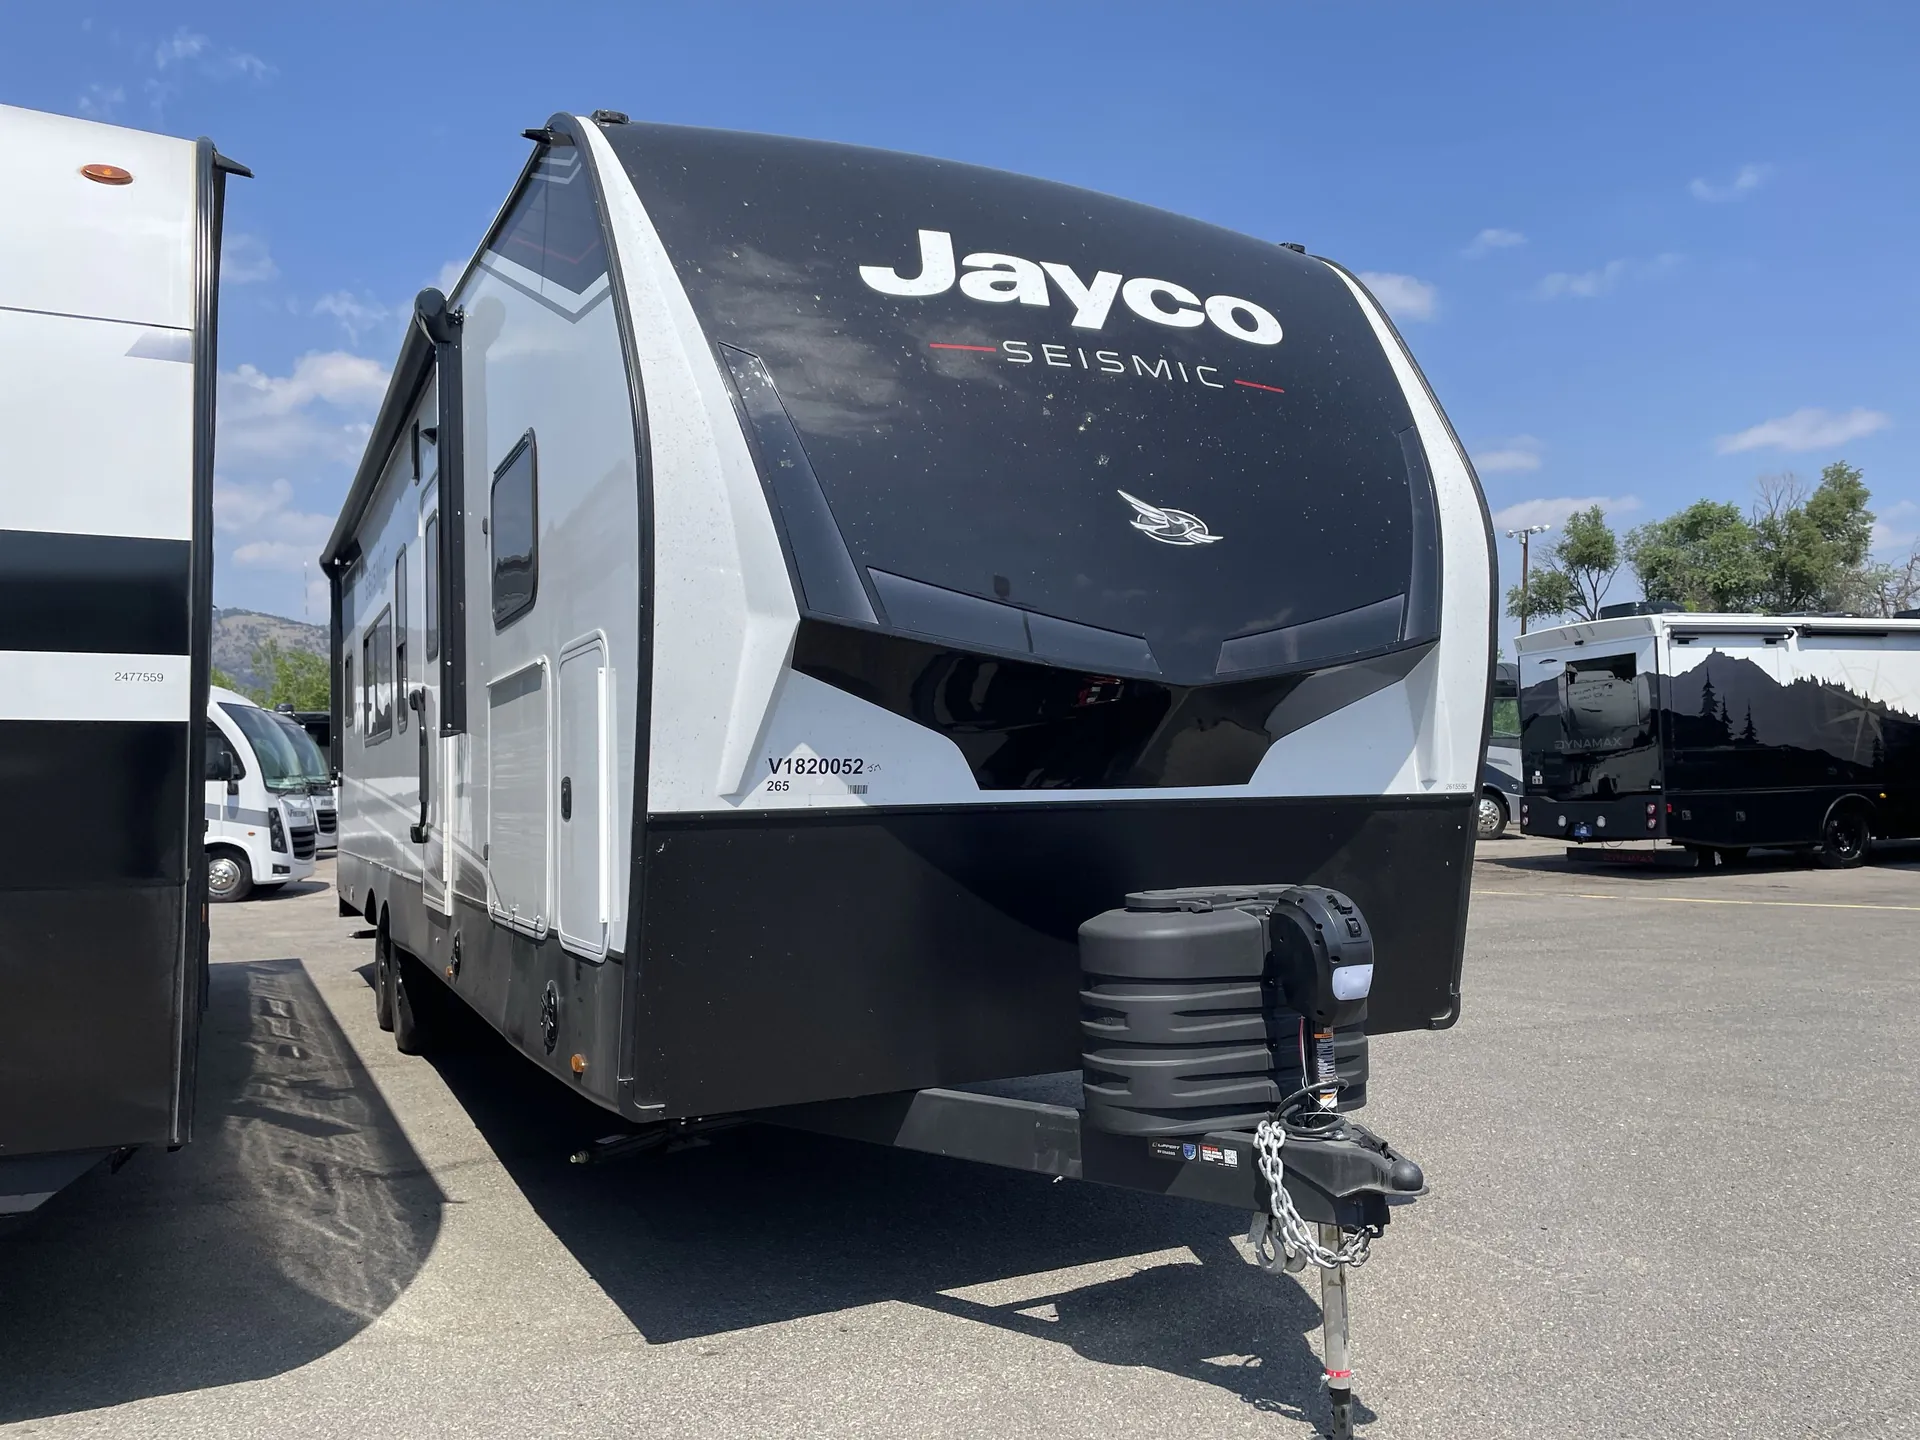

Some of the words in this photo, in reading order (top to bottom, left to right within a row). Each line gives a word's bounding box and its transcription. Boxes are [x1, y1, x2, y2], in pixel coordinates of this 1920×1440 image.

[859, 229, 1284, 346] Jayco
[1002, 340, 1224, 389] SEISMIC
[114, 671, 164, 682] 2477559
[768, 758, 864, 775] V1820052
[766, 780, 790, 792] 265
